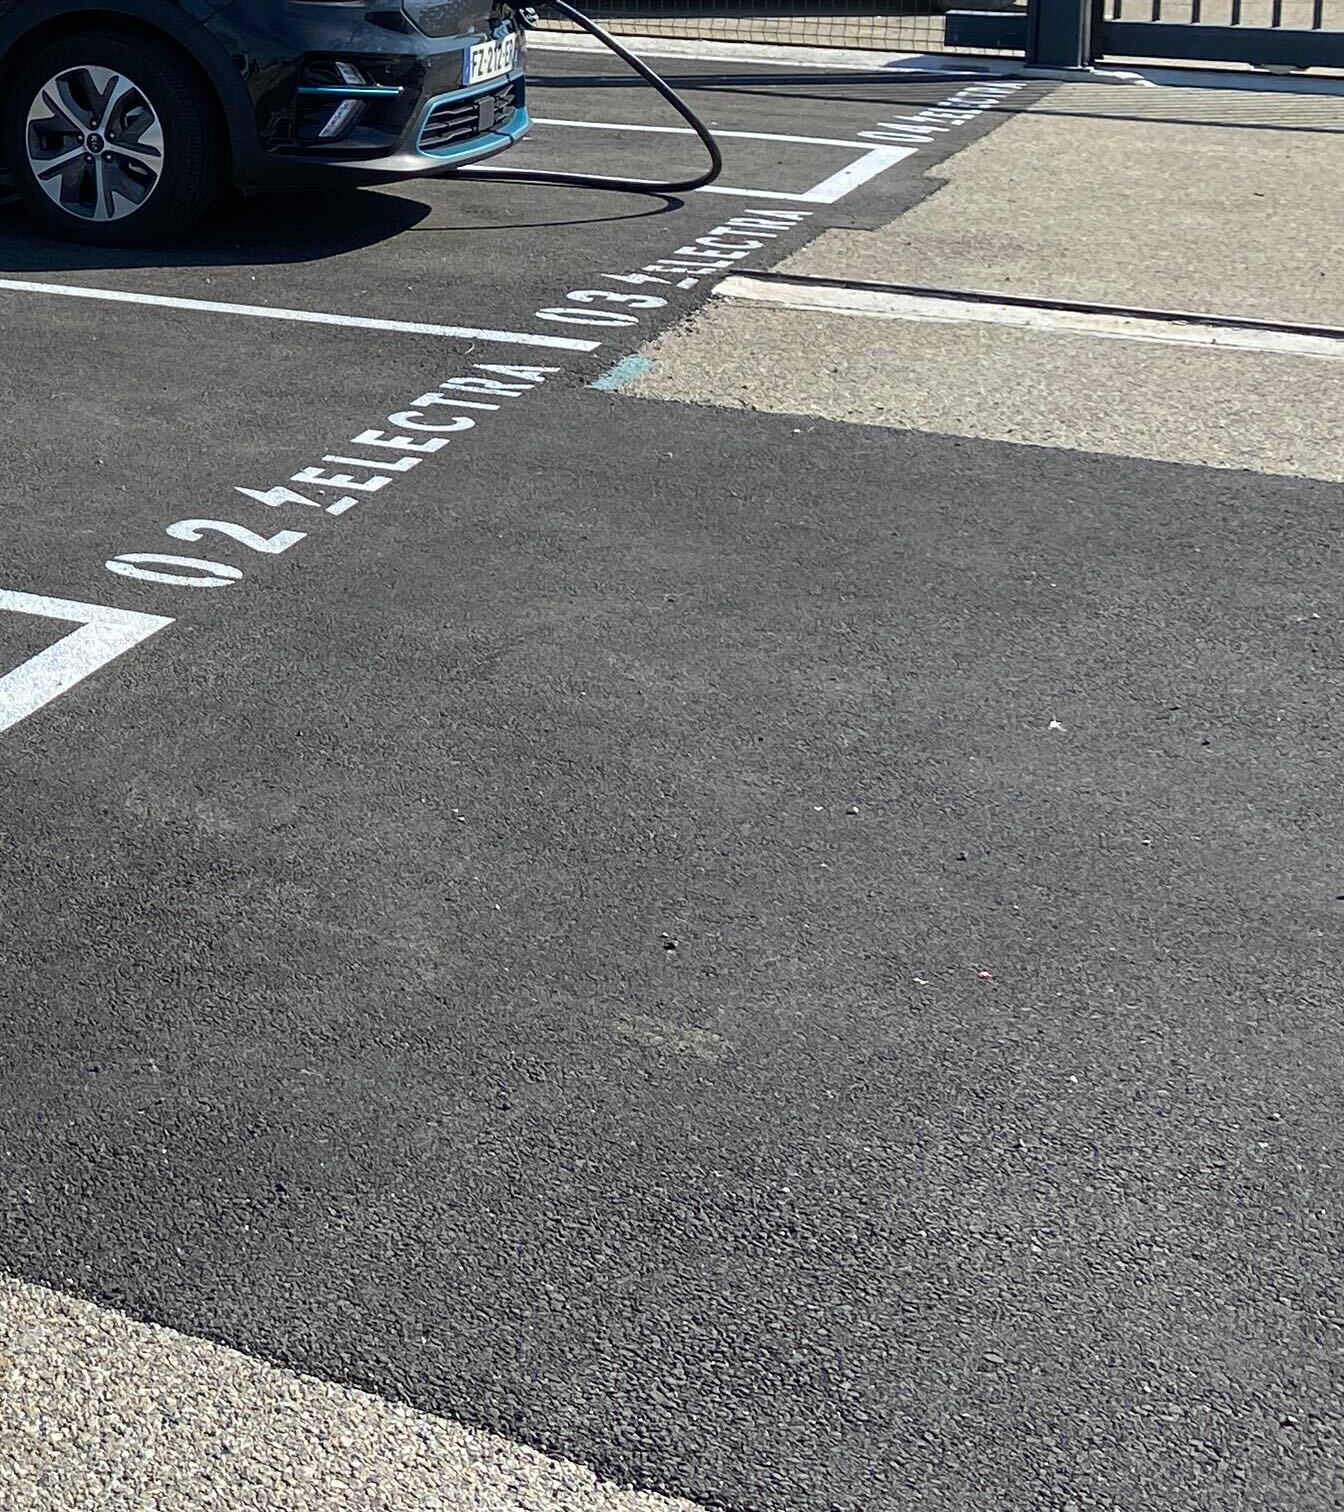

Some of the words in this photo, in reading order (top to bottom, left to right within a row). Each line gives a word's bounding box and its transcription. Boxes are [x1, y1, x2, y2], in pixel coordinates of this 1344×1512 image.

[535, 290, 668, 327] 03
[642, 209, 813, 275] ELECTRA
[104, 518, 308, 587] 02
[290, 363, 561, 492] ELECTRA
